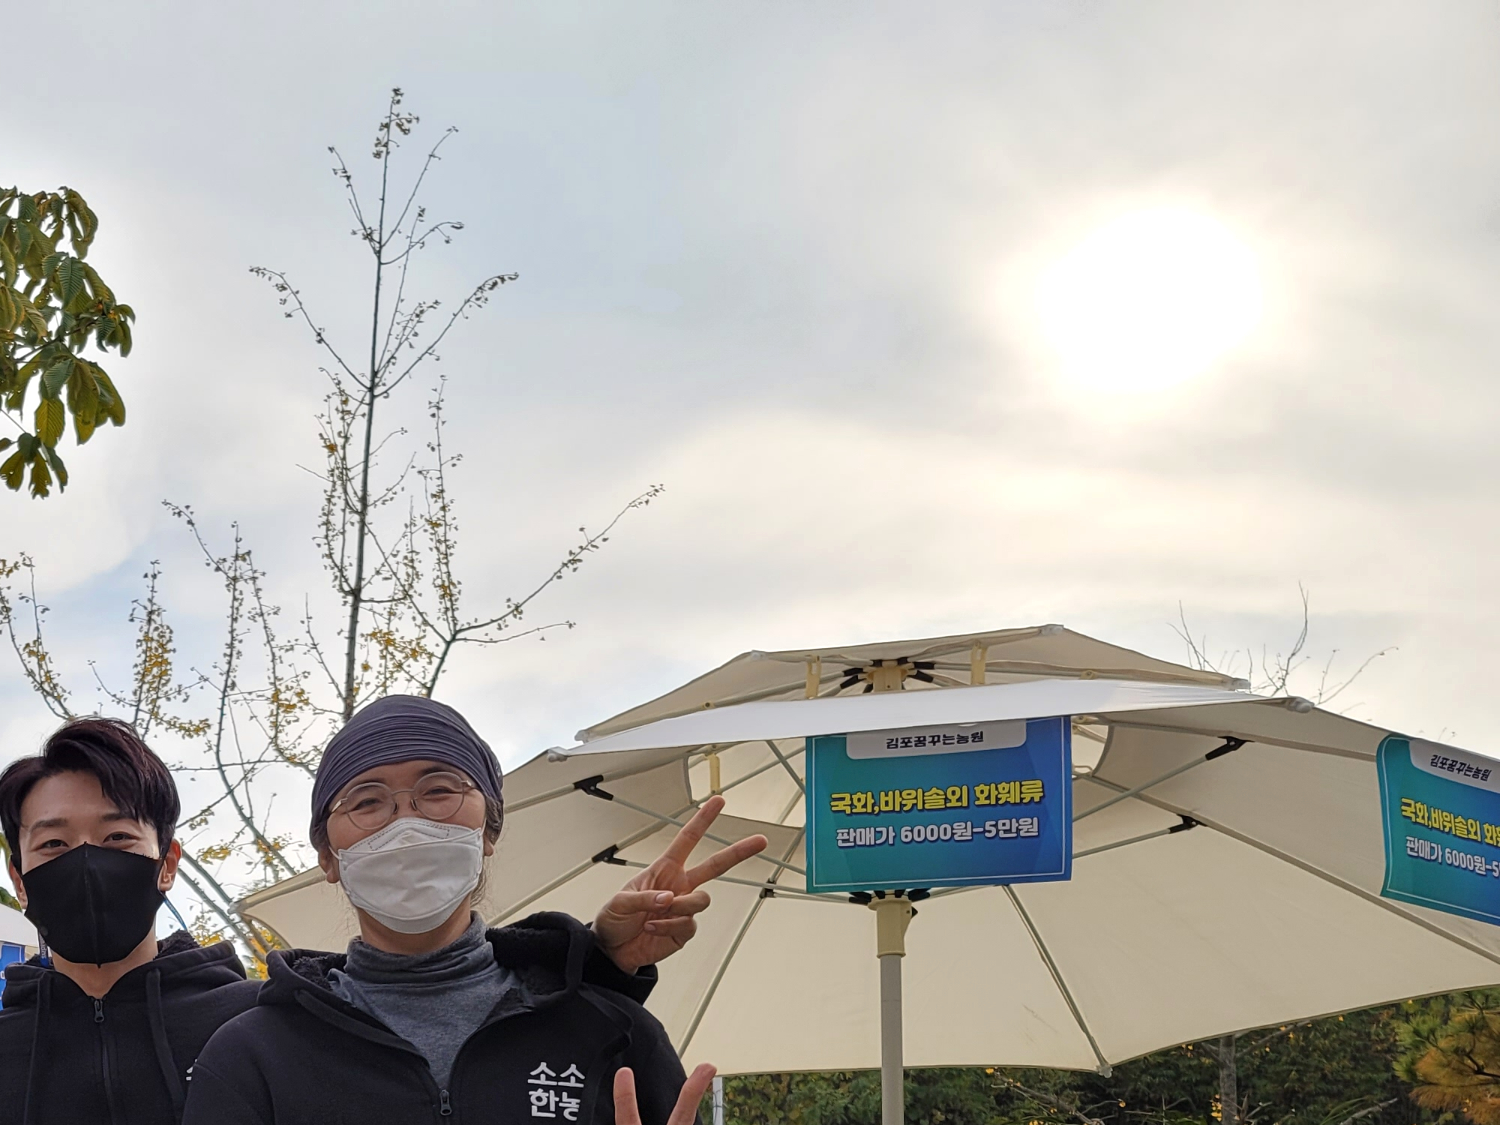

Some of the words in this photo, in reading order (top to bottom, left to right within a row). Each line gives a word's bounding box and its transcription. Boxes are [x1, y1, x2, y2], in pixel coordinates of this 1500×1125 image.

[886, 731, 984, 749] 김포꿈꾸는농원
[1430, 754, 1492, 781] 김포꿈꾸는농원
[830, 785, 968, 814] 국화,바위솔외
[974, 779, 1044, 806] 화훼류
[836, 826, 895, 847] 판매가
[900, 817, 1039, 843] 6000원-5만원
[1401, 798, 1481, 842] 국화,바위솔외
[1405, 836, 1443, 863] 판매가
[1445, 848, 1500, 877] 6000원-5
[527, 1061, 585, 1088] 소소
[528, 1088, 581, 1121] 한농
